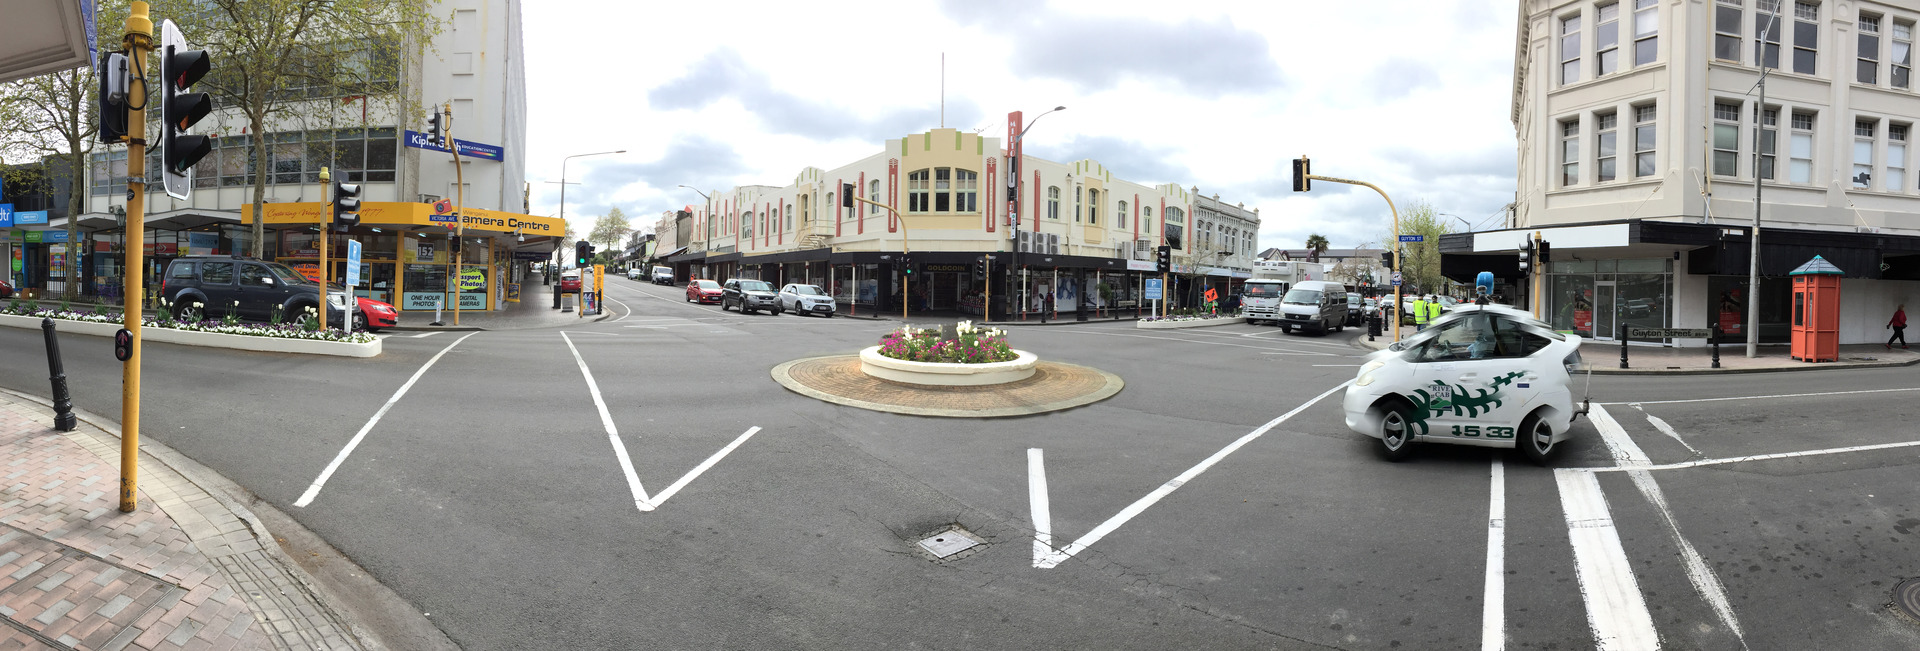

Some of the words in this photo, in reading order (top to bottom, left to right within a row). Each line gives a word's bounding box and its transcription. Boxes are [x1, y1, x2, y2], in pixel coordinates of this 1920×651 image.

[508, 218, 550, 231] Centre
[418, 246, 434, 256] 152
[1632, 329, 1662, 338] Guyton
[1664, 329, 1692, 337] Street
